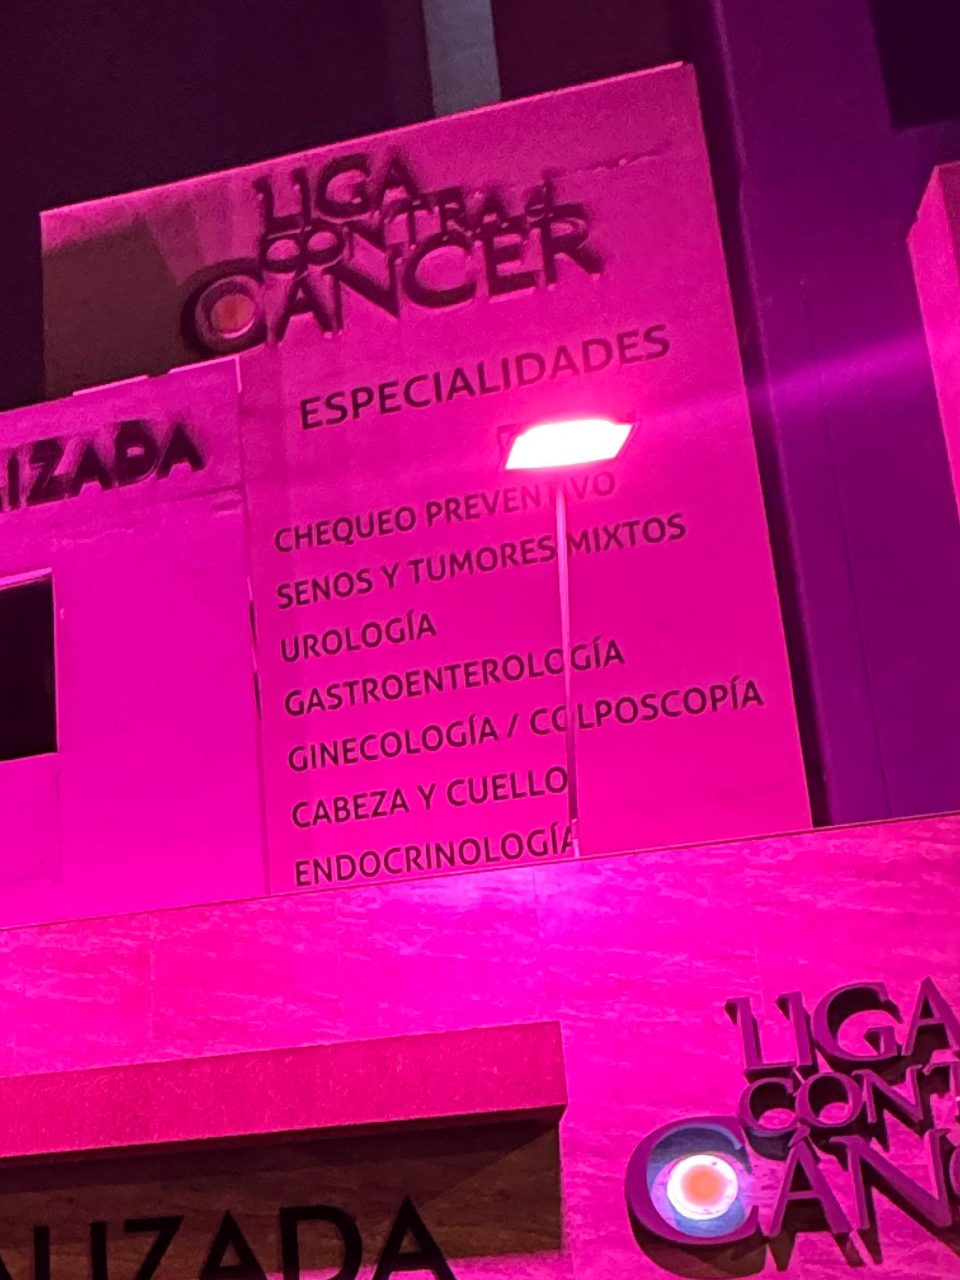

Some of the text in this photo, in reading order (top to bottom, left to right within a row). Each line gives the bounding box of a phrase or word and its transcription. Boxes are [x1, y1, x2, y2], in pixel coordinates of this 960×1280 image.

[300, 324, 672, 430] ESPECIALIDADES
[274, 506, 417, 553] CHEQUEO
[276, 512, 687, 610] SENOS Y TUMORES MIXTOS
[280, 610, 438, 663] UROLOGÍA
[284, 636, 626, 717] GASTROENTEROLOGÍA
[288, 713, 499, 772] GINECOLOGÍA
[529, 676, 765, 737] COLPOSCOPÍA
[291, 765, 569, 829] CABEZA Y CUELLO
[724, 976, 960, 1069] LIGA
